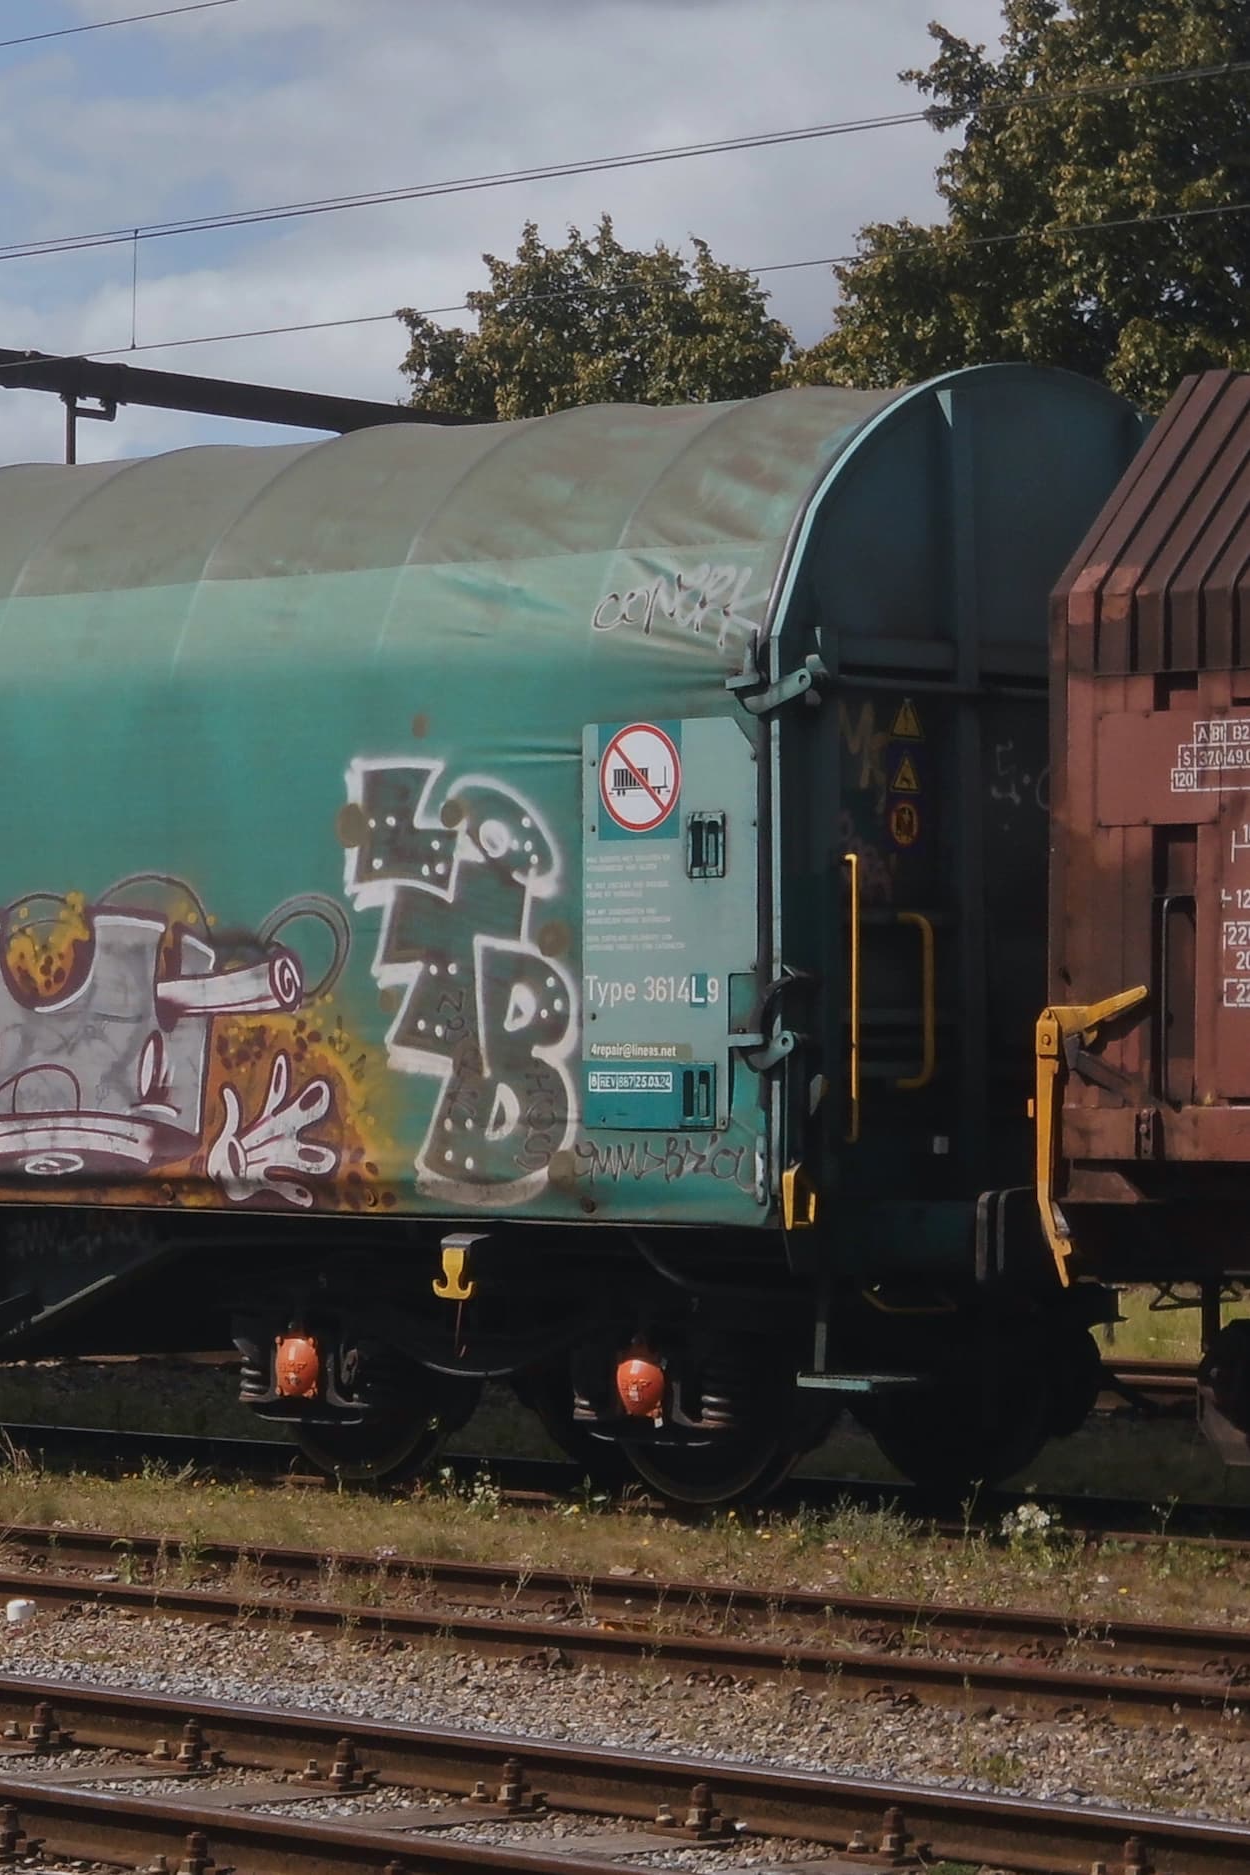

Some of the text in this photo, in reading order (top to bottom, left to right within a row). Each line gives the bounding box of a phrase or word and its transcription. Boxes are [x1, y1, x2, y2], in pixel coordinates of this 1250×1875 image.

[1197, 726, 1209, 742] A
[1212, 726, 1224, 741] B1
[1183, 751, 1191, 766] S
[1174, 772, 1194, 787] 120
[585, 975, 719, 1008] Type 3614L9
[591, 1043, 677, 1058] 4repair@lineas.net
